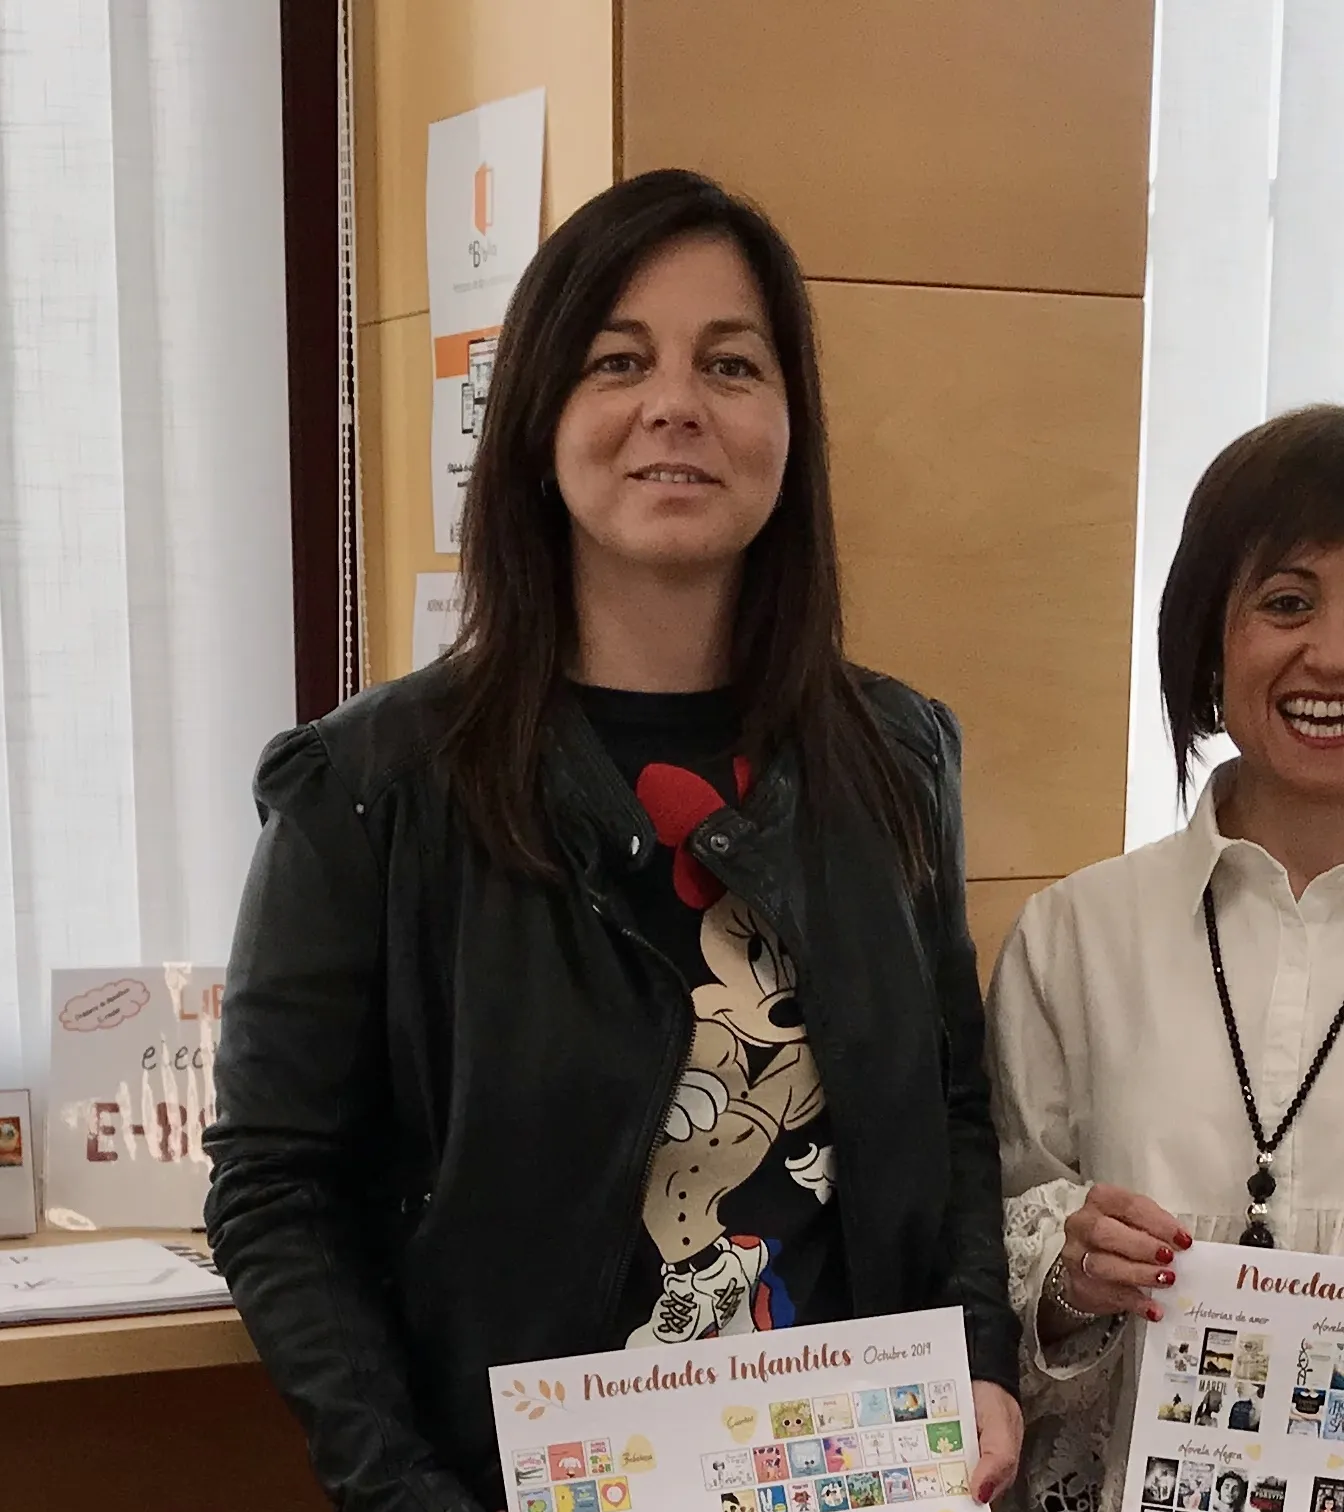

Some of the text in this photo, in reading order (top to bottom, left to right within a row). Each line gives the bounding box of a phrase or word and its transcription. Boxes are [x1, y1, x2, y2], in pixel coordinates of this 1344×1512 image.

[1184, 1301, 1233, 1322] Historias
[1235, 1310, 1247, 1323] de
[584, 1341, 932, 1401] Novedades Infantiles Octubre 2019
